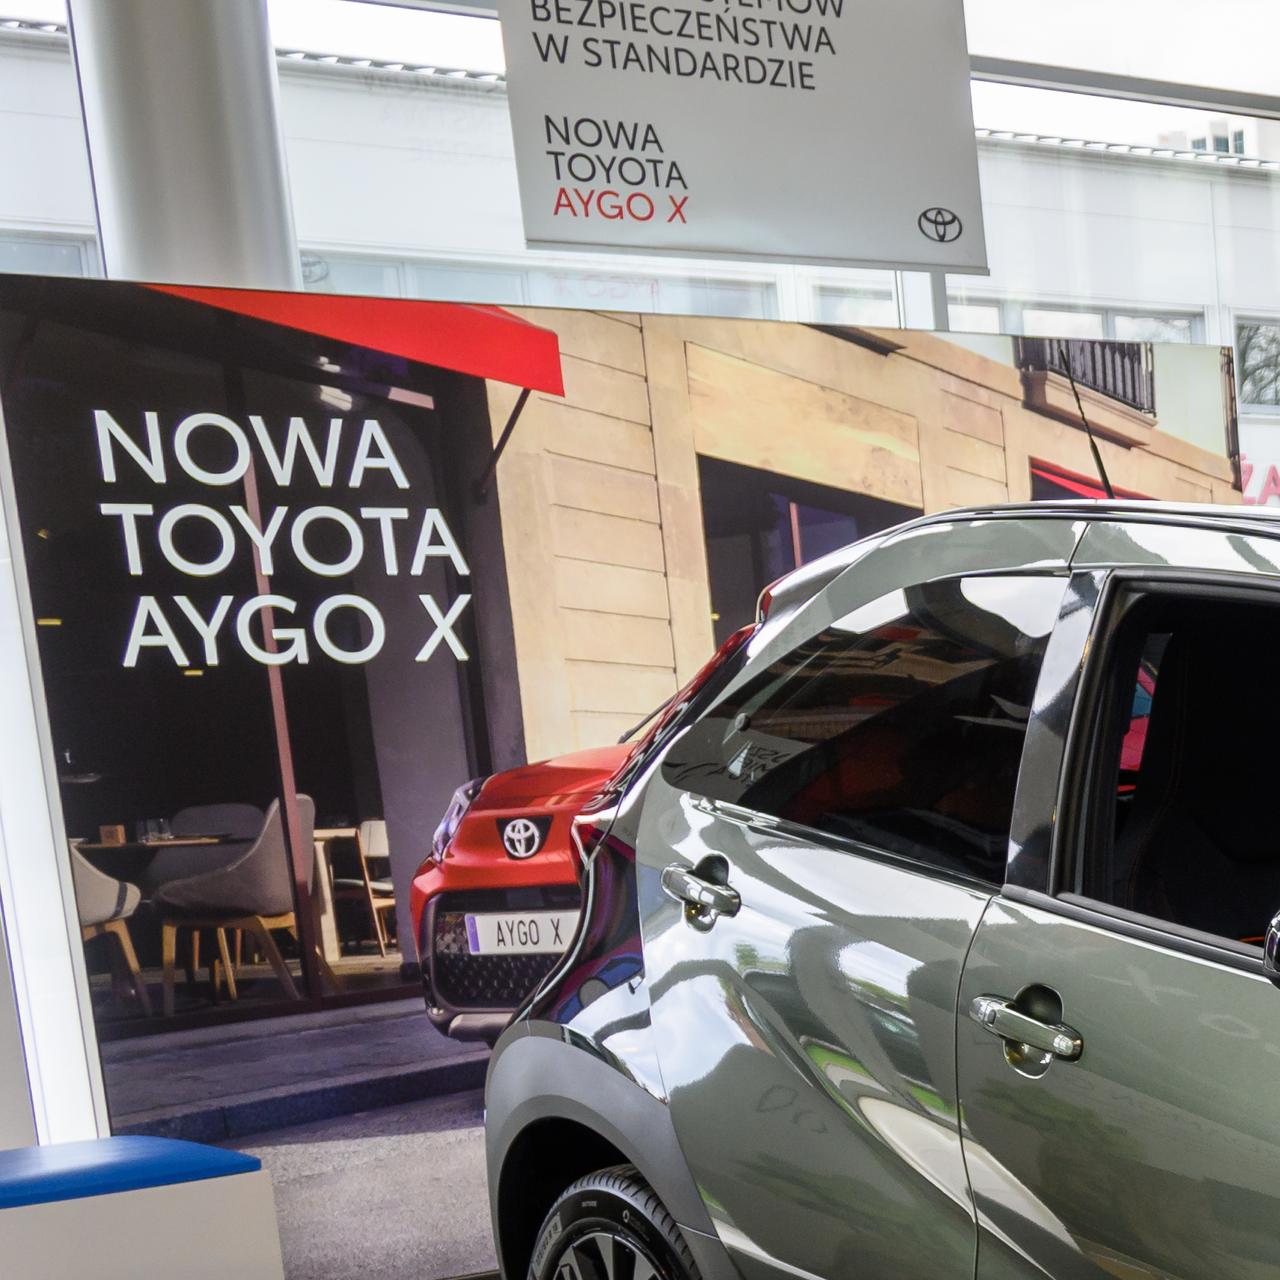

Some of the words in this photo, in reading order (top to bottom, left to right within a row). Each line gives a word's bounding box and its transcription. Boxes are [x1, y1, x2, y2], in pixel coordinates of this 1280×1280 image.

[531, 0, 836, 55] BEZPIECZEŃSTWA
[533, 32, 568, 64] W
[583, 37, 816, 90] STANDARDZIE
[544, 115, 664, 153] NOWA
[546, 151, 688, 190] TOYOTA
[553, 187, 655, 222] AYGO
[667, 195, 689, 224] X
[94, 409, 410, 489] NOWA
[100, 503, 470, 577] TOYOTA
[123, 594, 386, 668] AYGO
[414, 594, 472, 662] X
[496, 919, 540, 947] AYGO
[550, 918, 563, 945] X
